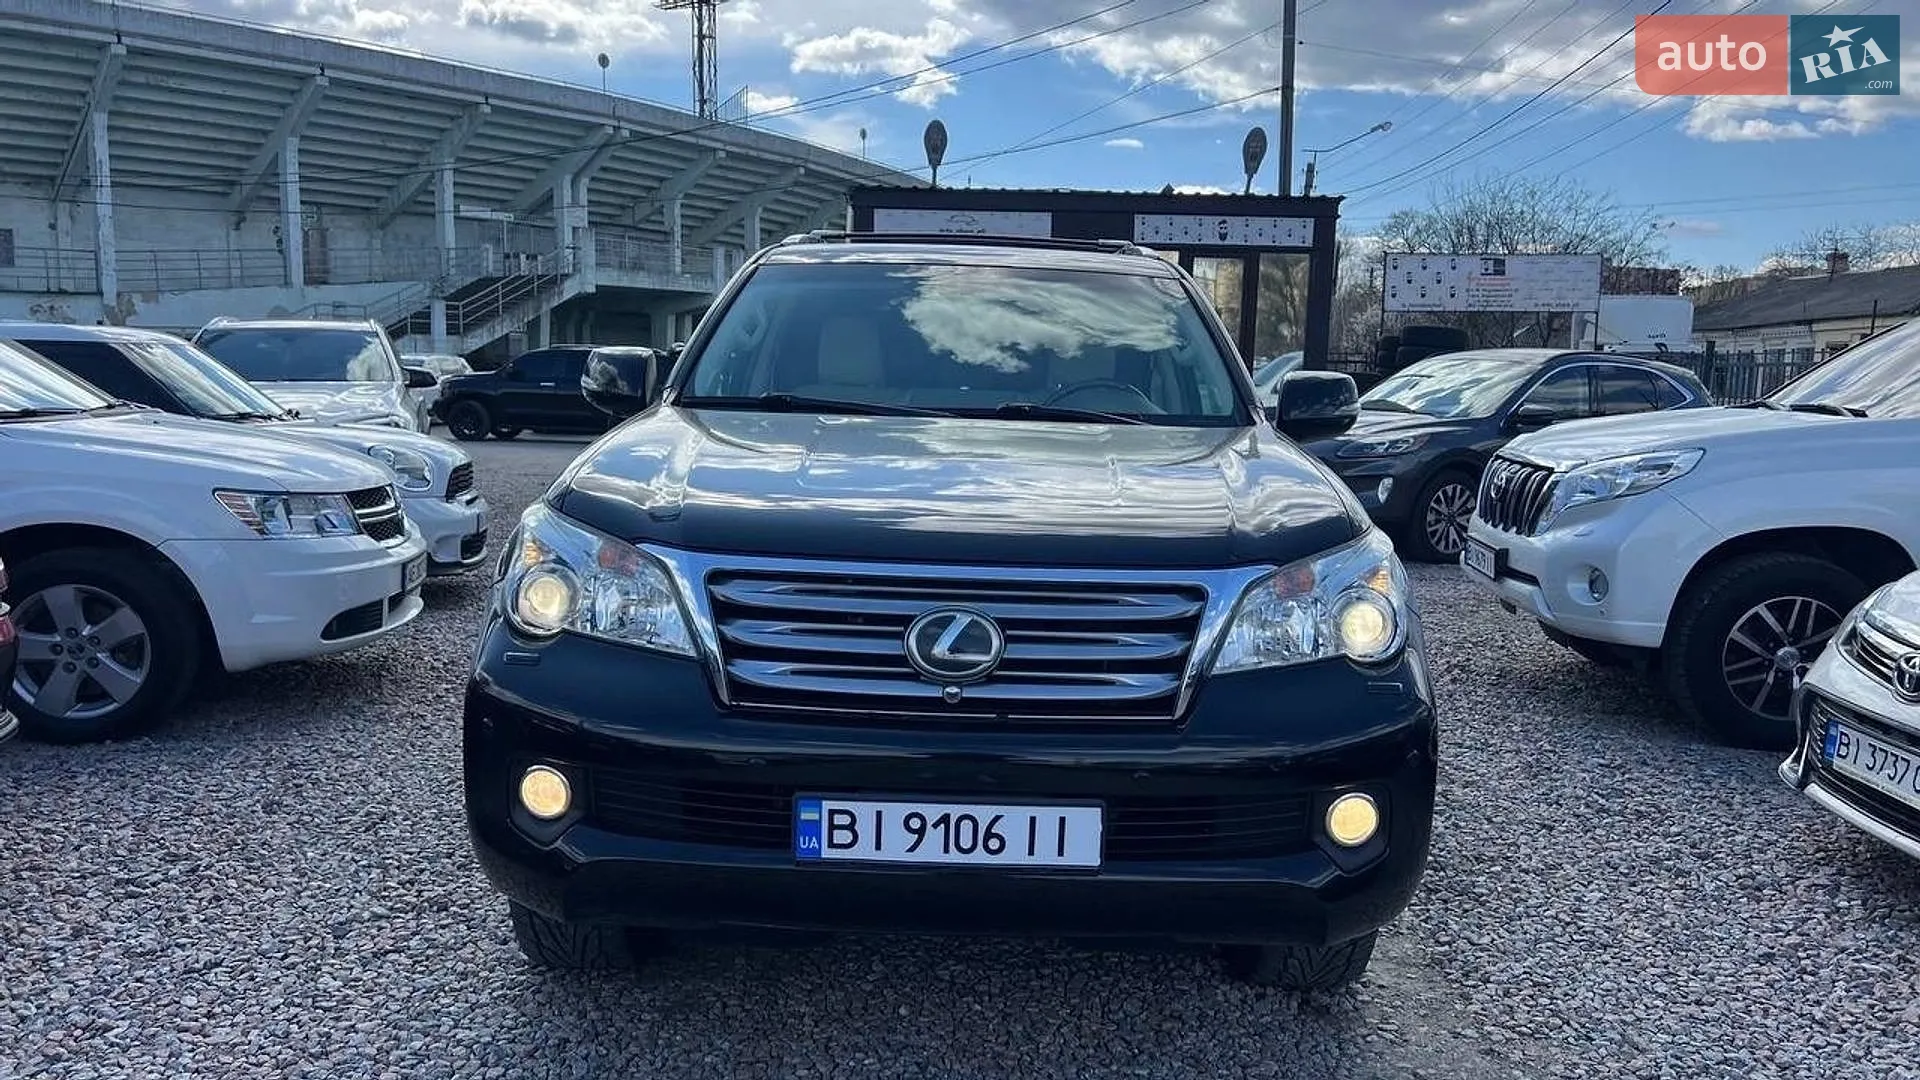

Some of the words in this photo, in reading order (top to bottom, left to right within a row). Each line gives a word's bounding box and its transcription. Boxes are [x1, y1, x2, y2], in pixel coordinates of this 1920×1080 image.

[1864, 742, 1911, 785] 3737
[799, 835, 819, 849] UA
[827, 808, 883, 851] BI
[902, 811, 1007, 856] 9106
